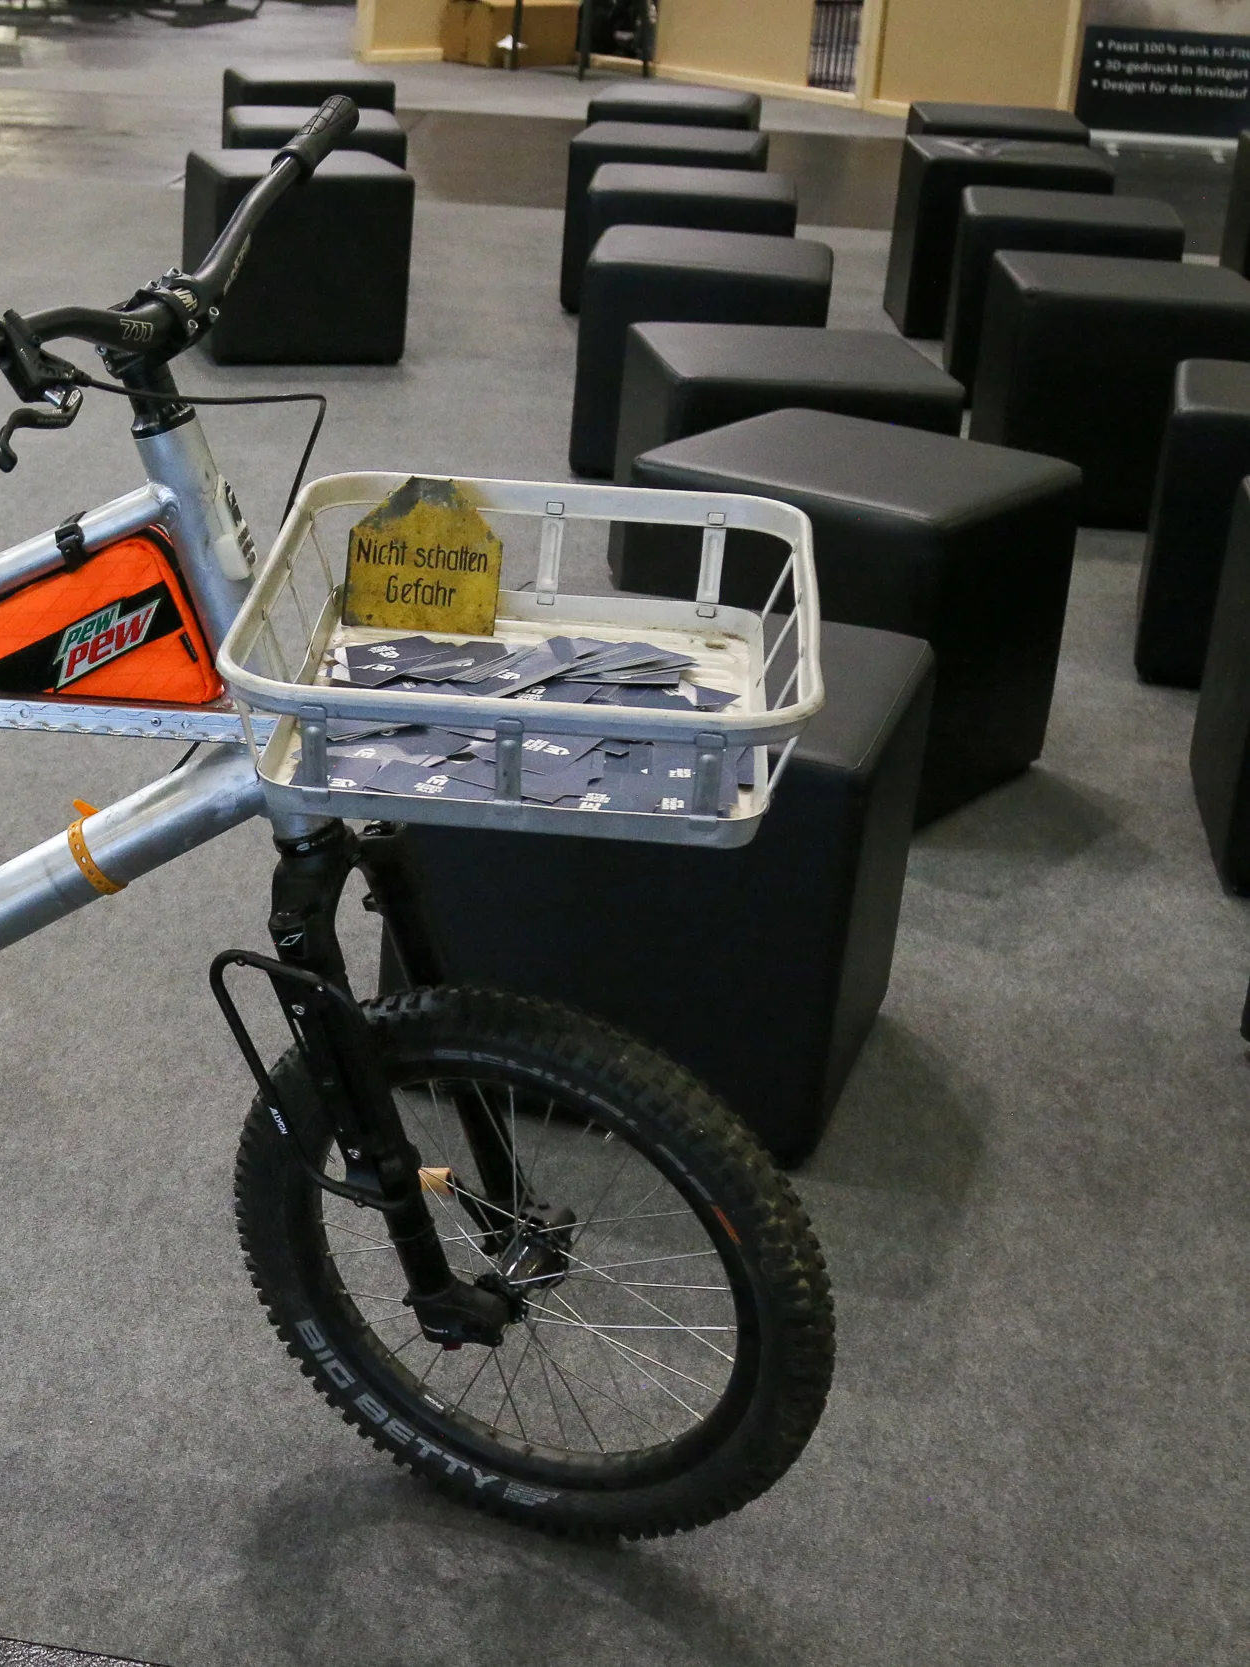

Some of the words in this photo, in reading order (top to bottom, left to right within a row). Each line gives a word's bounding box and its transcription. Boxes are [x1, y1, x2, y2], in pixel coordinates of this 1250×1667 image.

[356, 537, 407, 567] Nicht
[413, 543, 488, 573] schalten
[385, 575, 457, 607] Gefahr
[295, 1318, 358, 1390] BIG
[353, 1391, 501, 1490] BETTY
